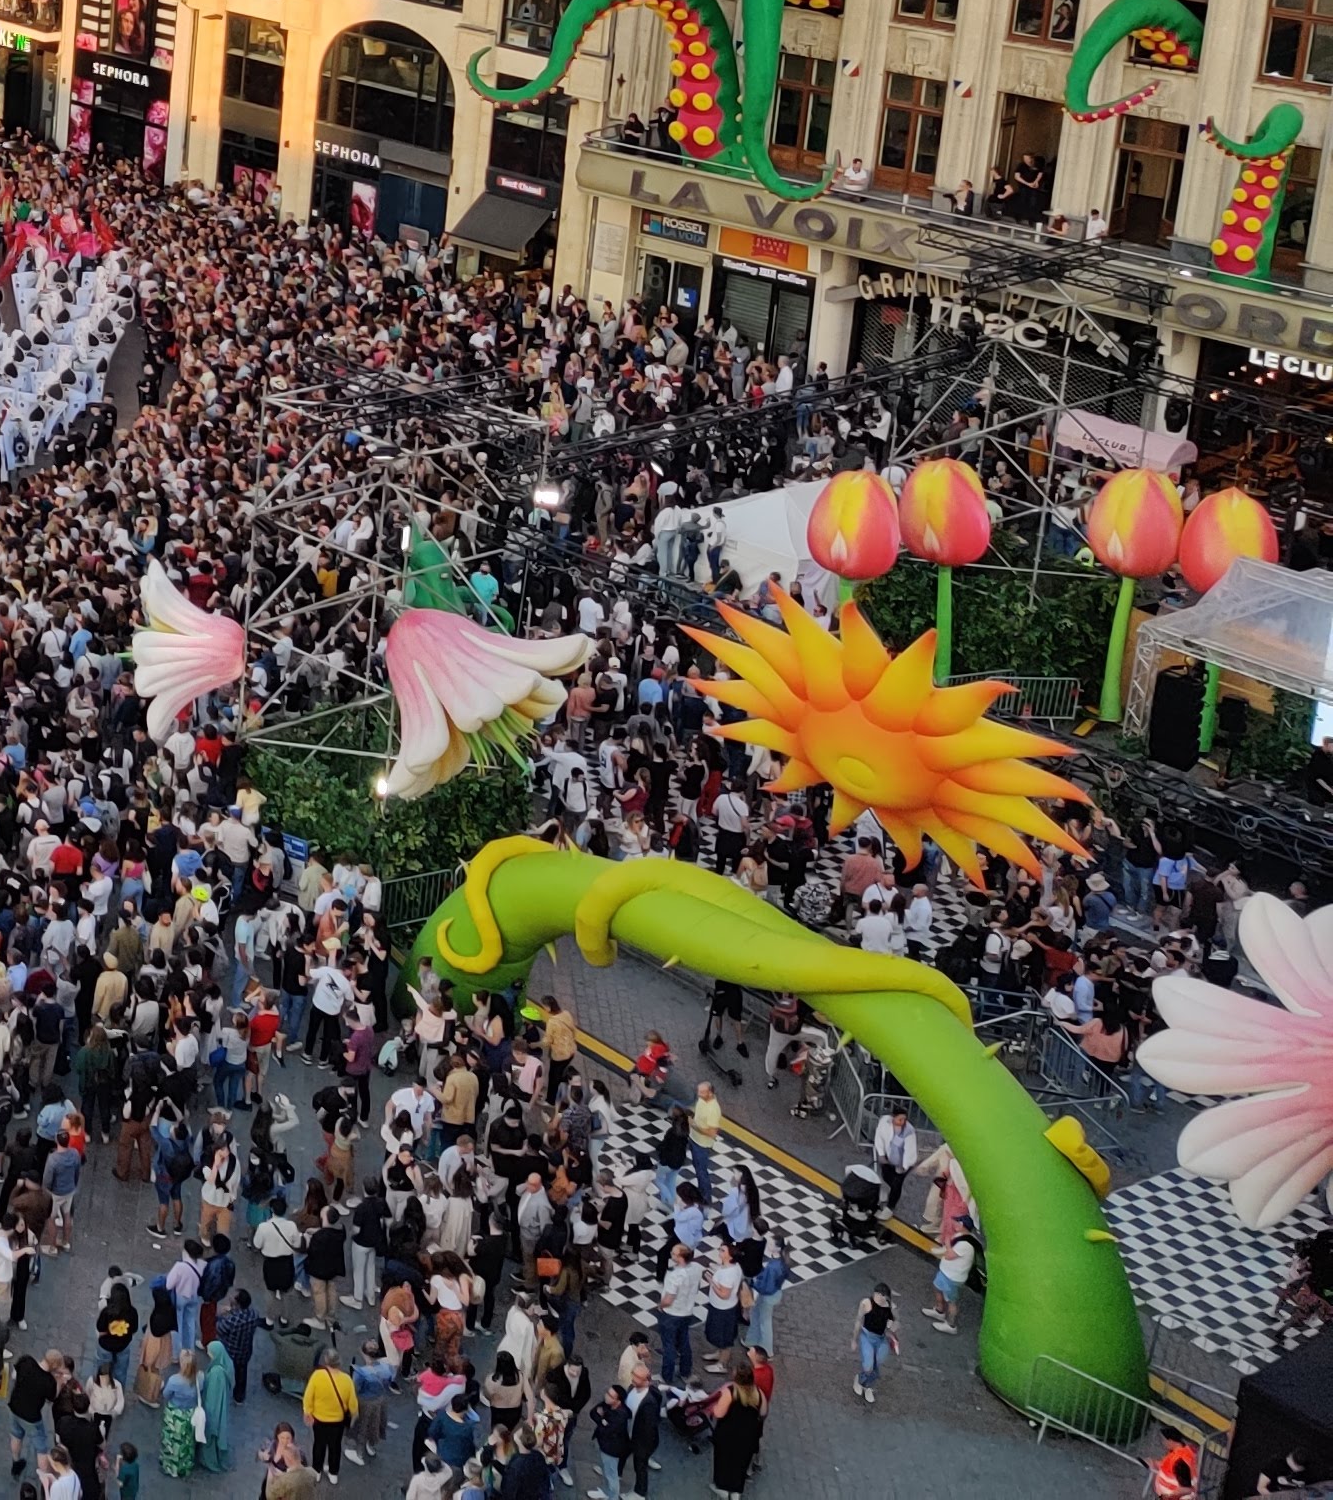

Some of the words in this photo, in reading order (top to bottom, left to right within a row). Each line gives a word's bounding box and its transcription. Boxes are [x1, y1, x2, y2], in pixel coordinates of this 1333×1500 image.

[92, 61, 150, 88] SEPHORA
[314, 139, 381, 169] SEPHORA
[629, 168, 712, 214] LA
[744, 193, 918, 260] VOIX
[662, 216, 706, 236] ROSSEL
[1248, 347, 1280, 370] LE
